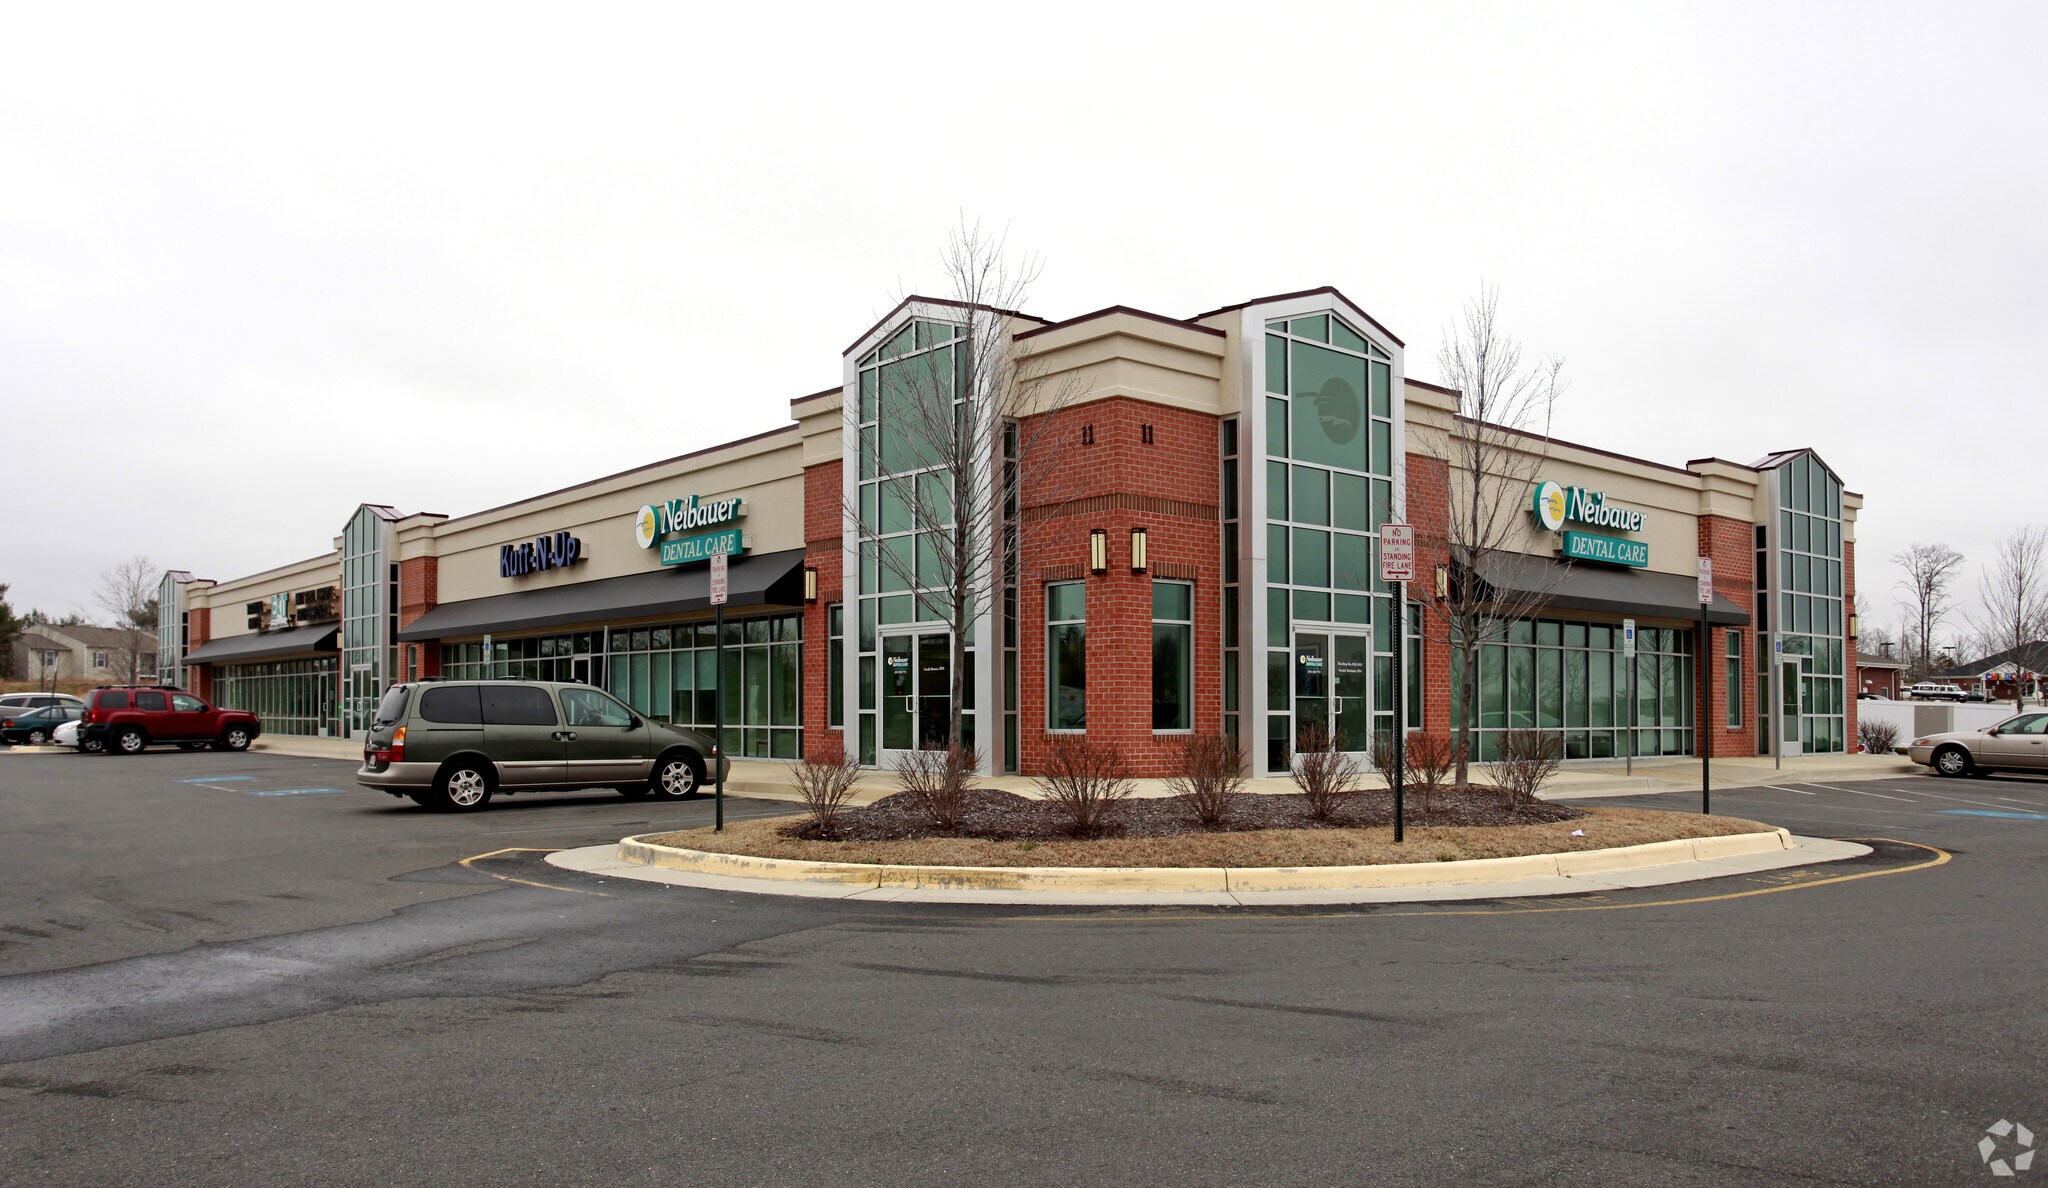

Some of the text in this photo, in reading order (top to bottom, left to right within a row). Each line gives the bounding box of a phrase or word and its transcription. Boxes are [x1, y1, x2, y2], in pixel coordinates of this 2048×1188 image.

[1081, 424, 1095, 446] 11
[1141, 423, 1155, 445] 11
[661, 495, 738, 534] Neibauer
[1569, 486, 1648, 532] Neibauer
[663, 533, 735, 562] DENTAL CARE
[1383, 538, 1411, 546] PARKING
[1571, 536, 1647, 563] DENTAL CARE
[1382, 562, 1412, 570] FIRE LANE
[1383, 552, 1412, 561] STANDING
